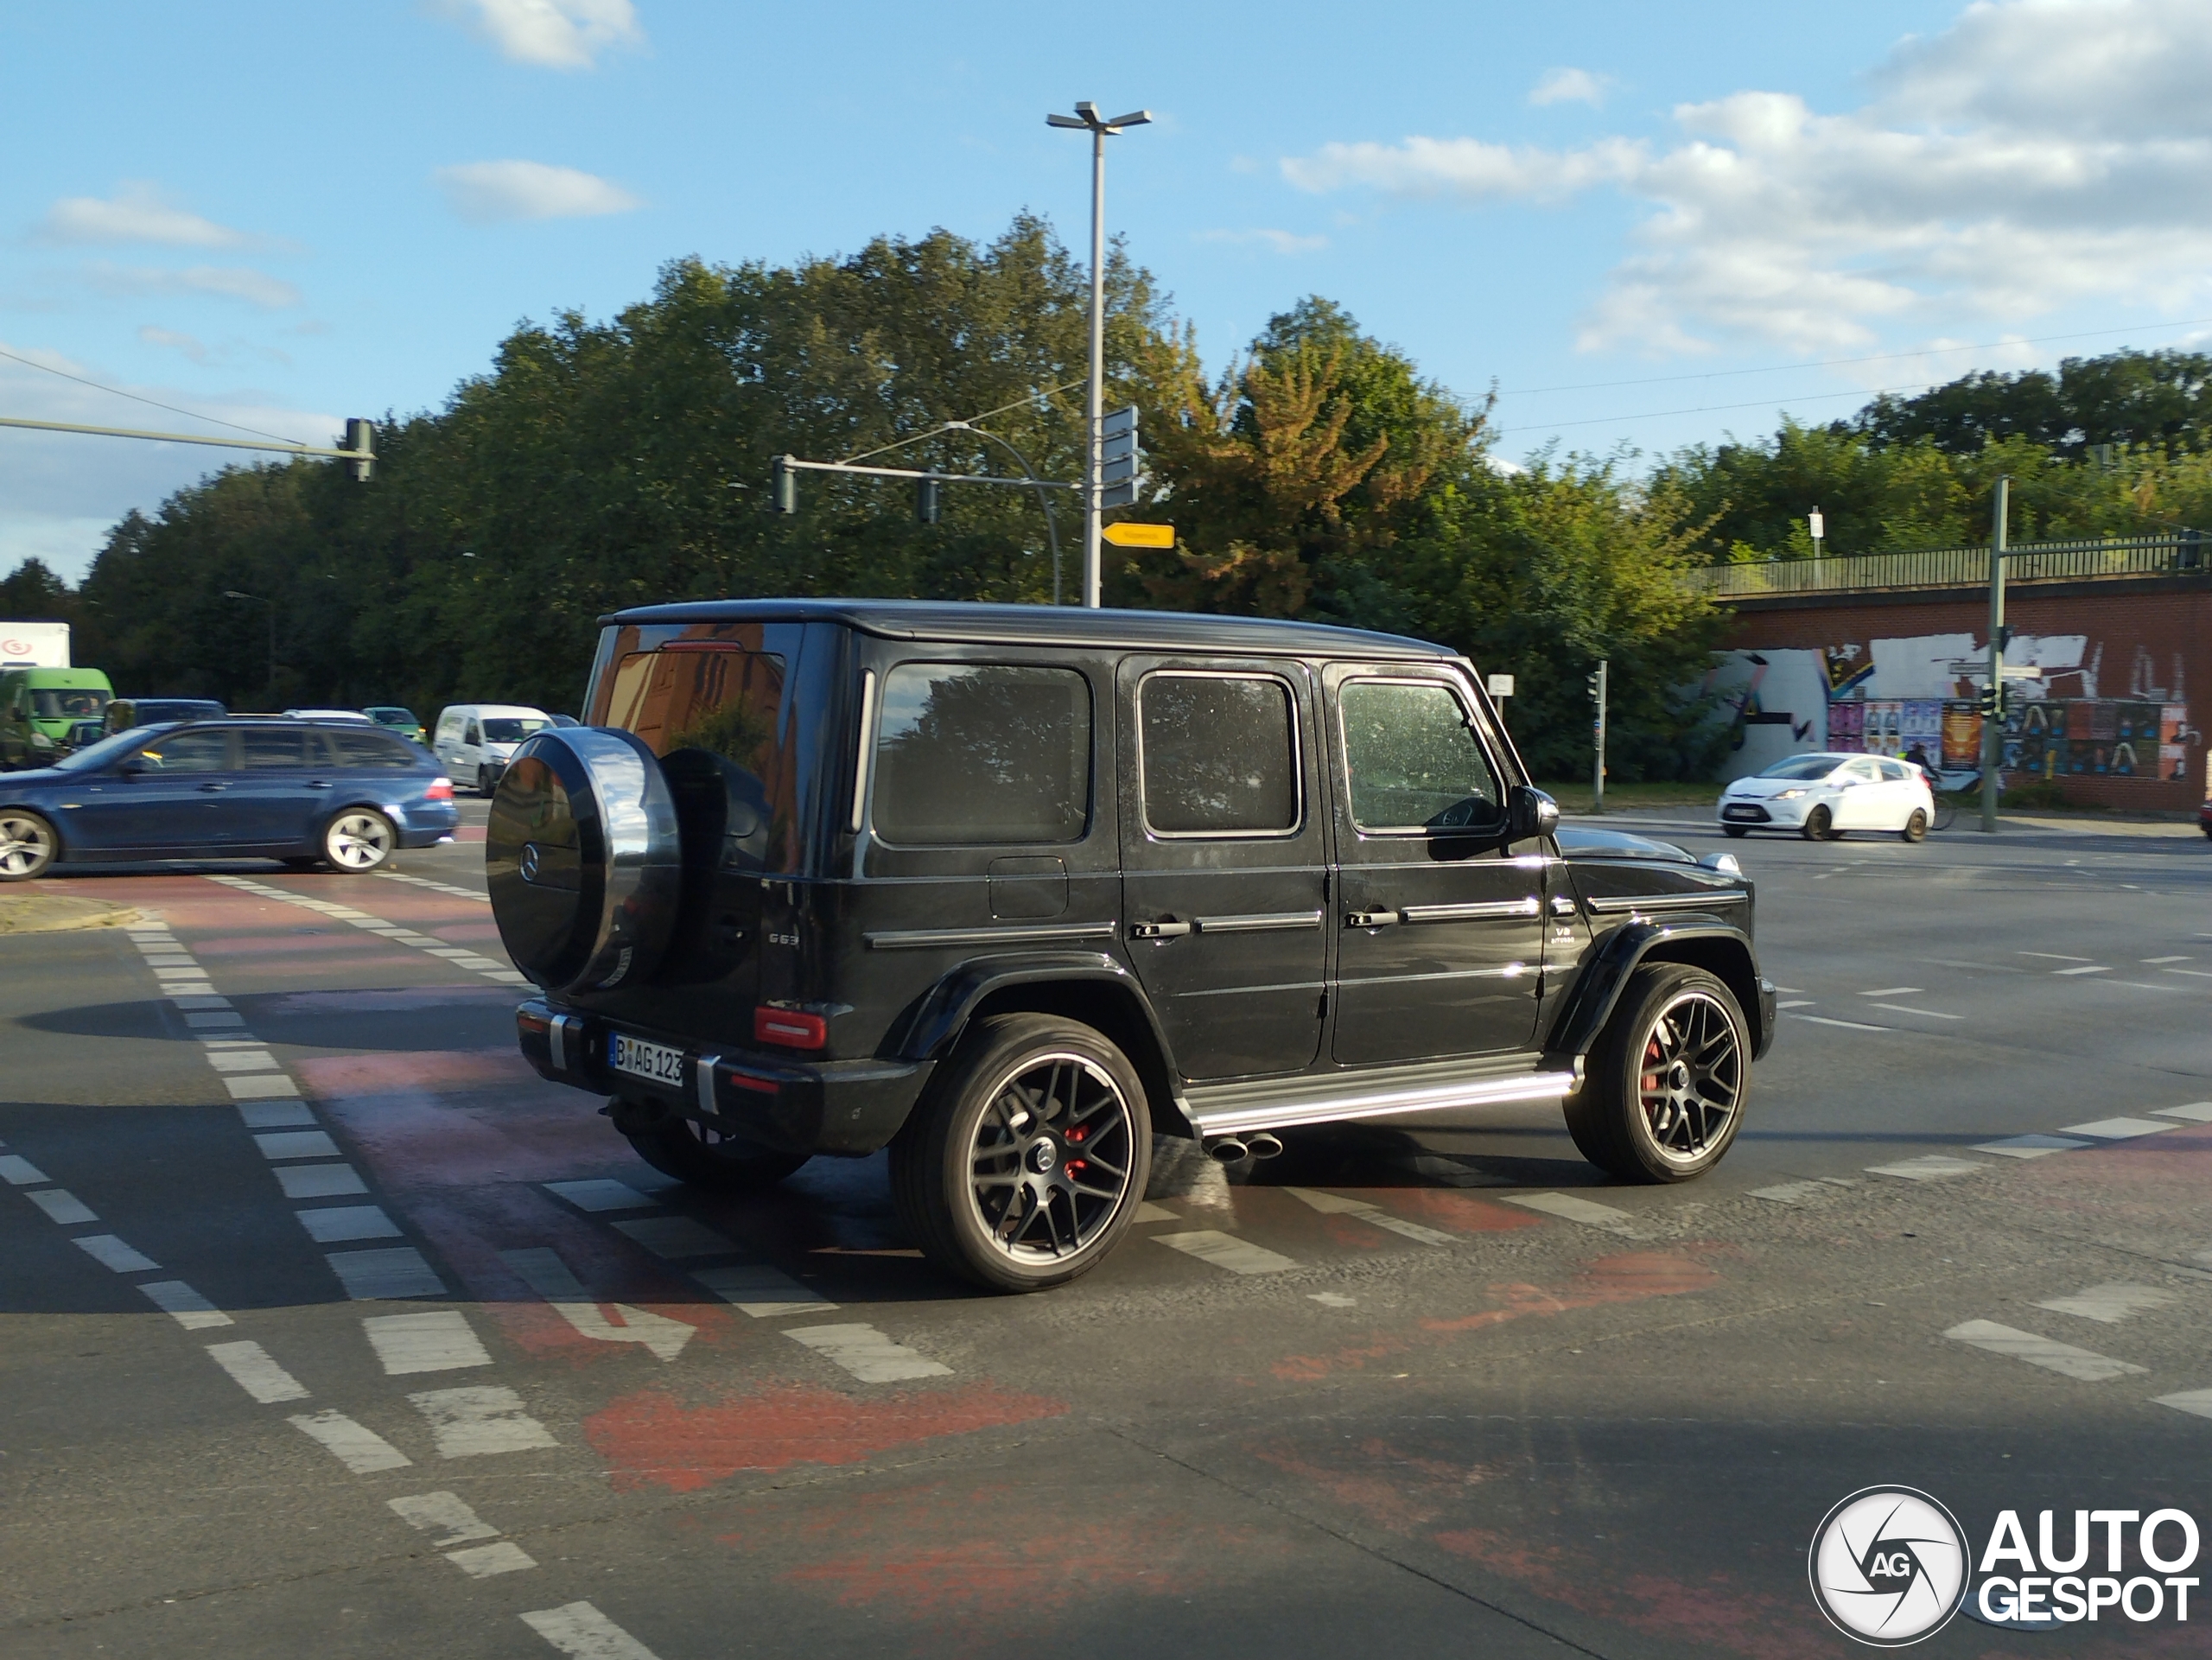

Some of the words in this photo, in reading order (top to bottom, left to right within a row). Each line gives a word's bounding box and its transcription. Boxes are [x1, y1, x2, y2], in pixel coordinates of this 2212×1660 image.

[616, 1039, 626, 1066] B
[634, 1044, 653, 1074] AG
[655, 1049, 683, 1082] 123
